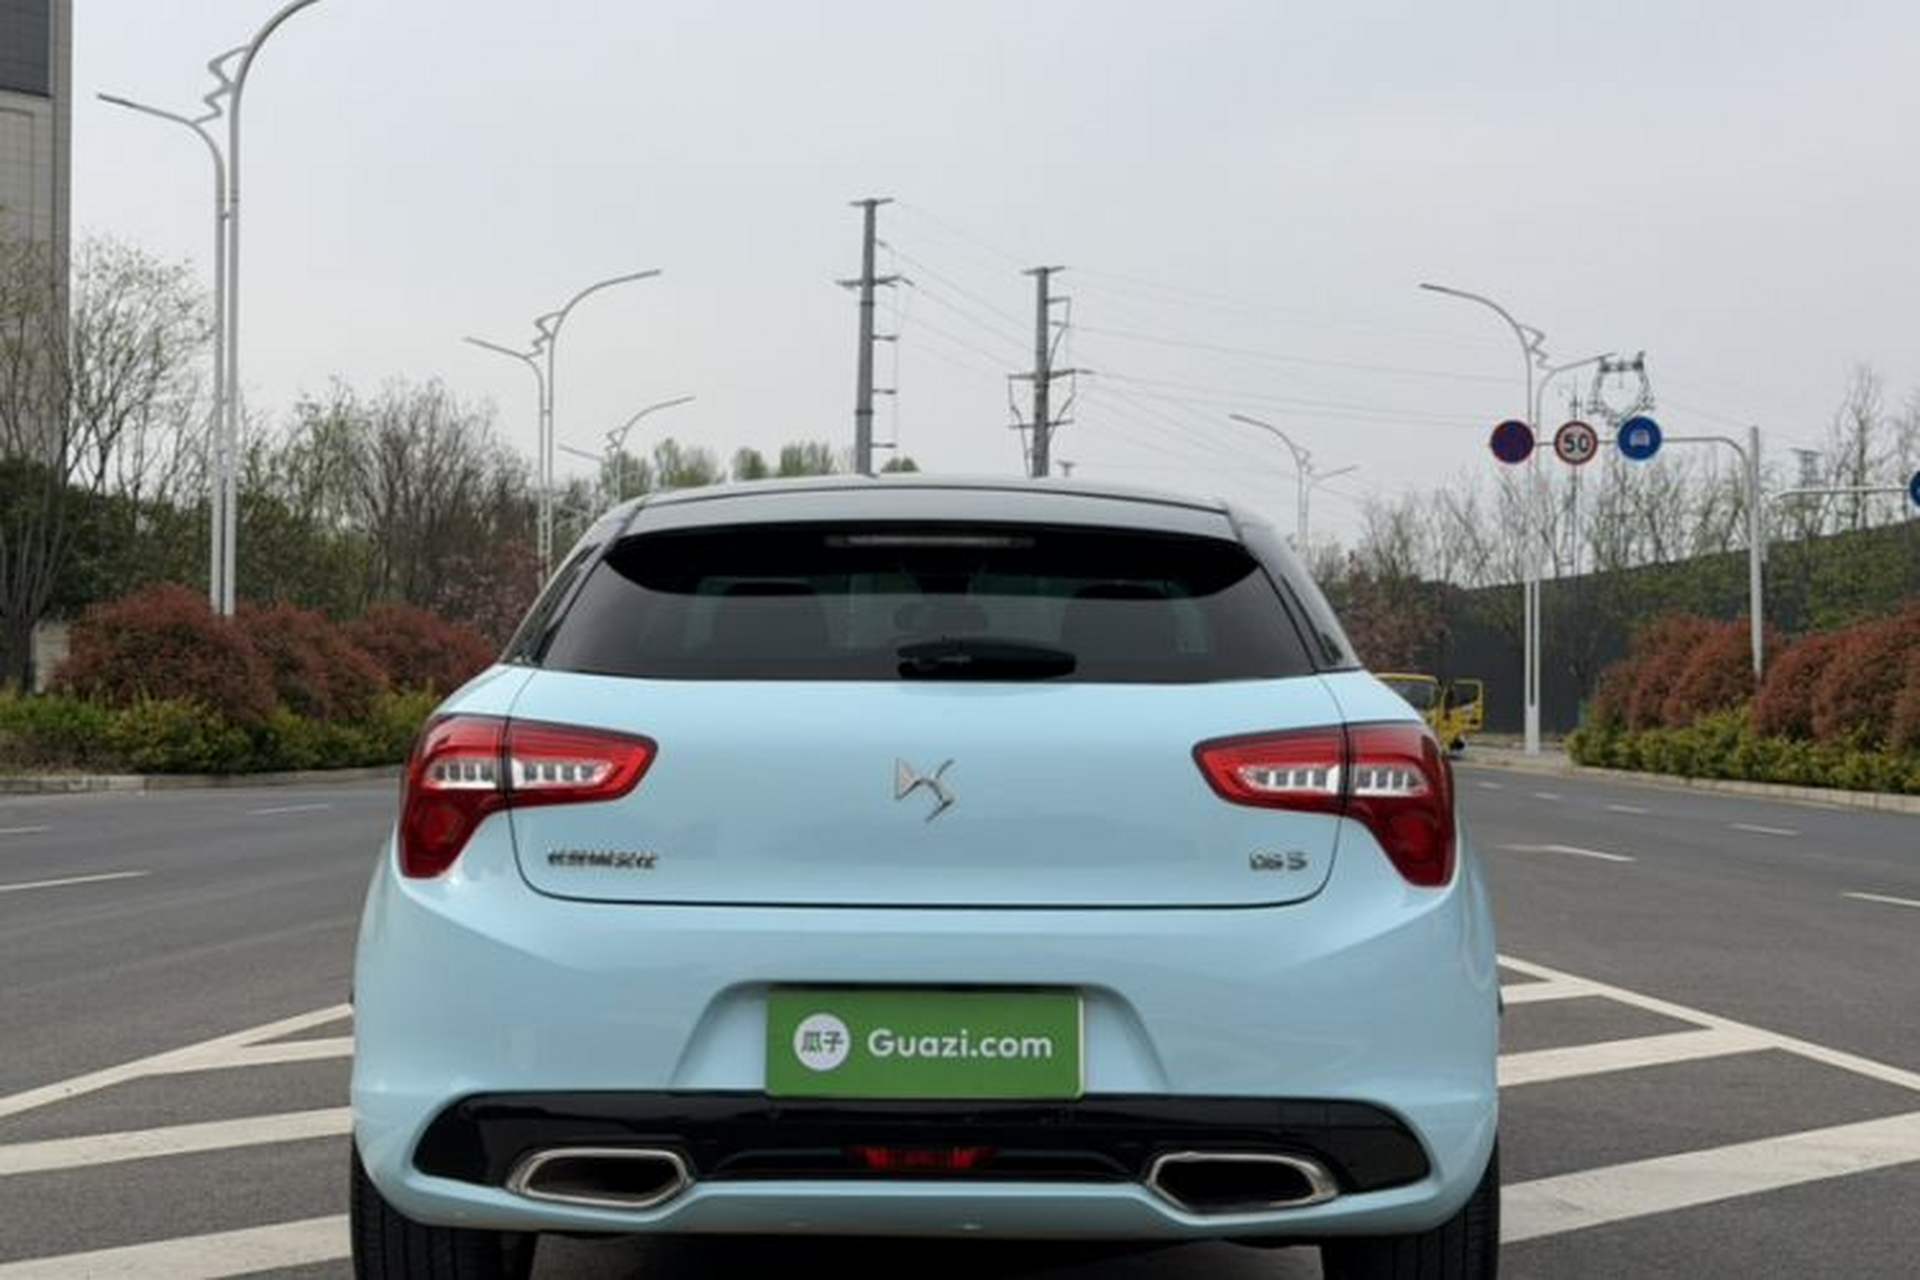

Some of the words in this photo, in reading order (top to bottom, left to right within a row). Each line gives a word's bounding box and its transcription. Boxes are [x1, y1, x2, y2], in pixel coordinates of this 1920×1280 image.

[1563, 432, 1590, 453] 50
[801, 1030, 844, 1054] 瓜子
[867, 1028, 1052, 1057] Guazi.com
